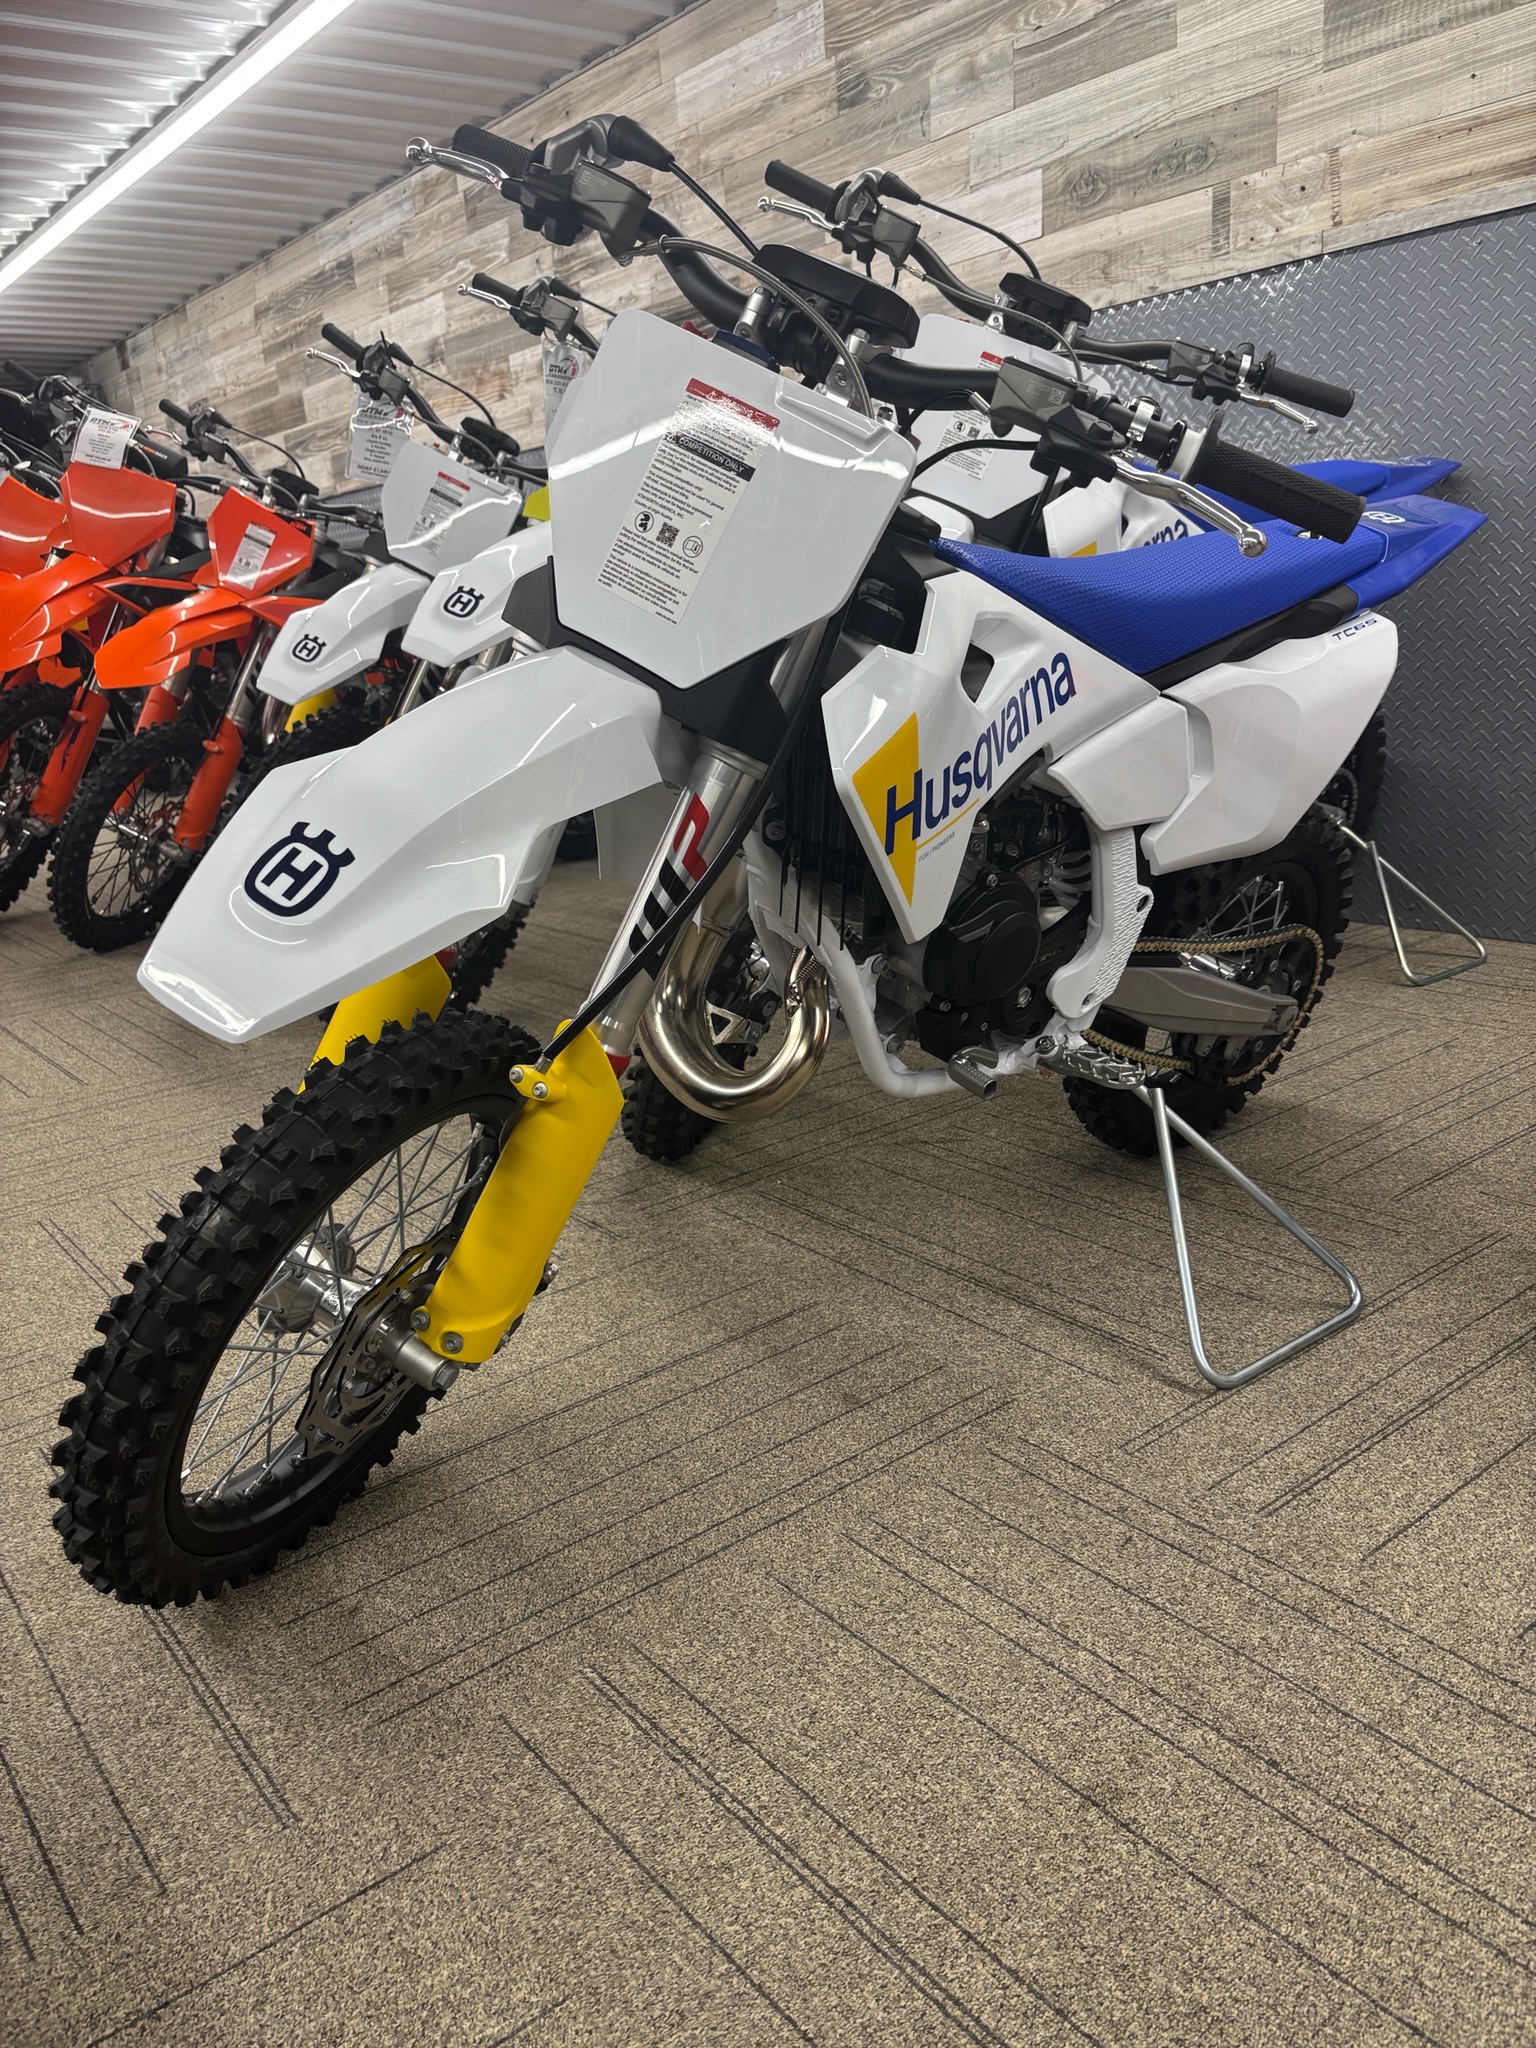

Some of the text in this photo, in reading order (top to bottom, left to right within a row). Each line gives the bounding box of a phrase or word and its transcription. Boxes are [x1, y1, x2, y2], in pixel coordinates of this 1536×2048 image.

[679, 436, 725, 463] COMPETITION
[725, 459, 744, 472] ONLY
[884, 651, 1077, 856] Husqvarna
